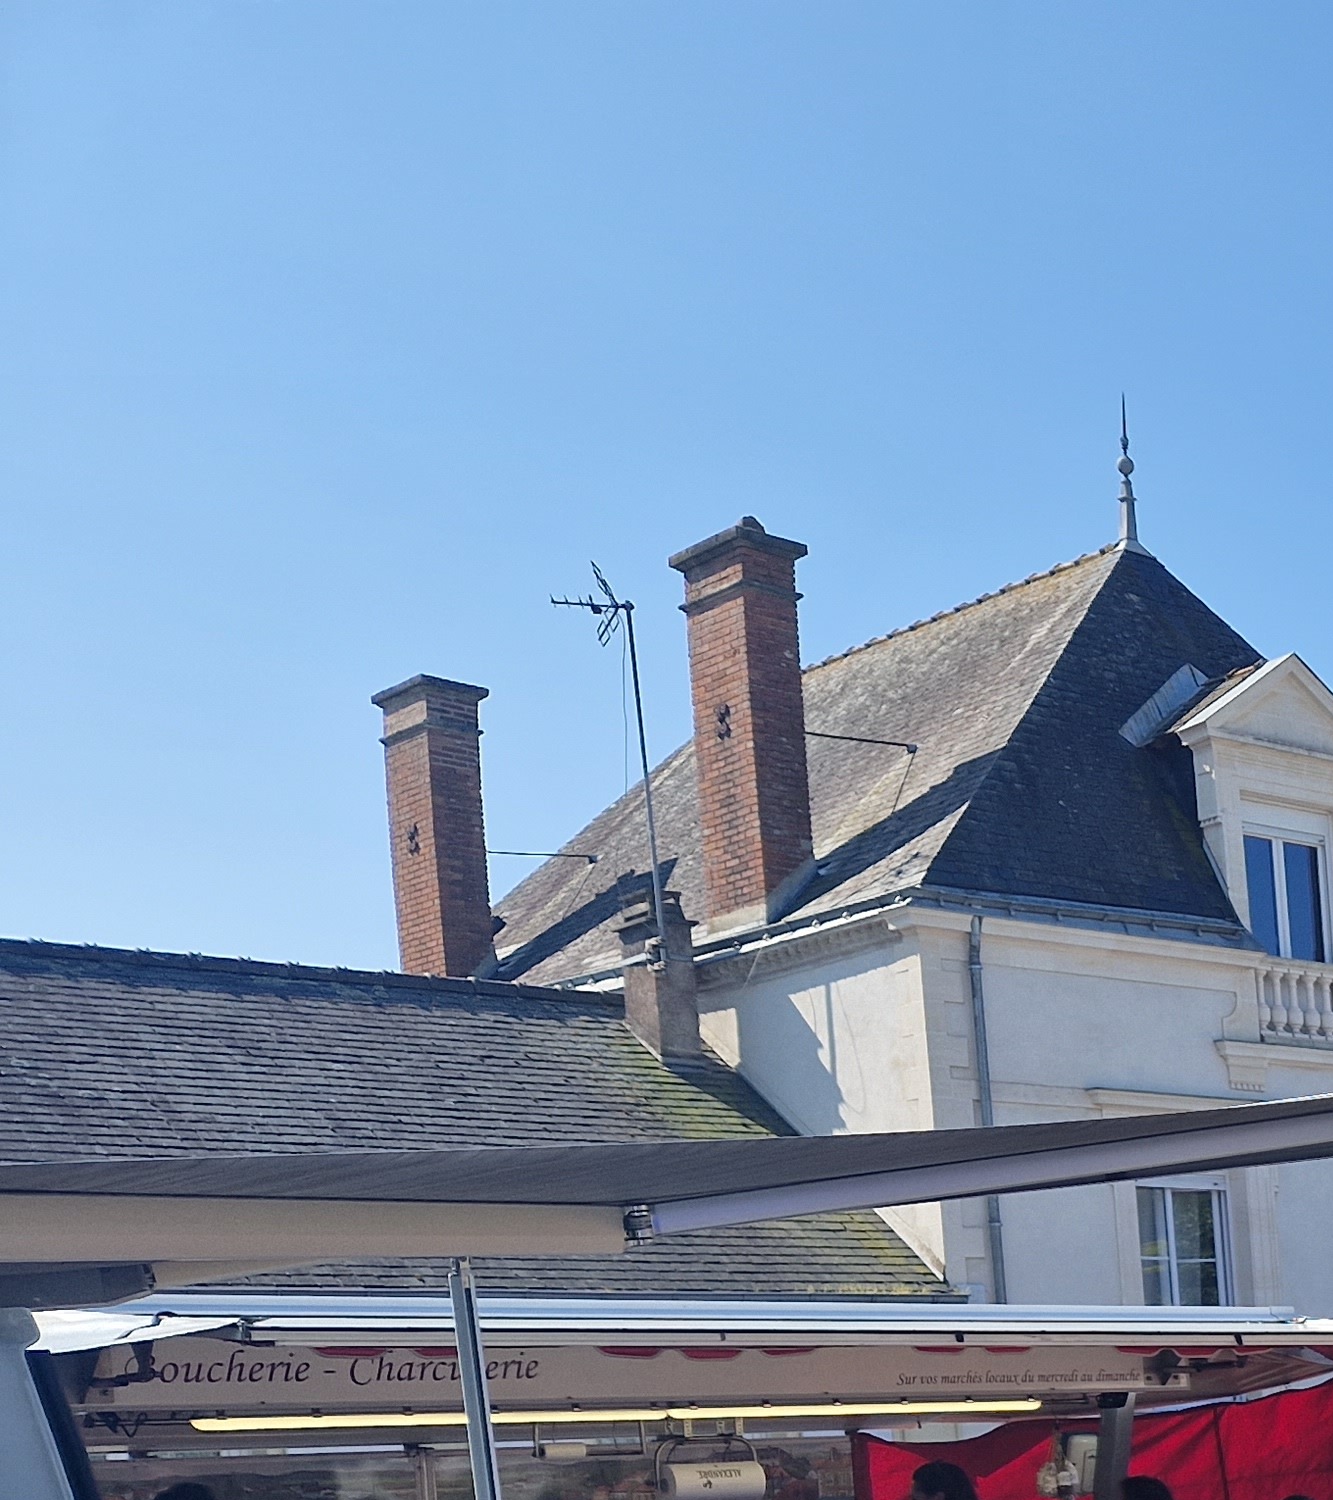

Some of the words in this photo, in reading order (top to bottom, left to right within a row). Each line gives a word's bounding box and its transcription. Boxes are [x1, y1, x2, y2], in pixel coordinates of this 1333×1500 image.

[349, 1350, 539, 1386] Charcuerie
[897, 1373, 916, 1386] Sur
[919, 1375, 938, 1385] vos
[941, 1371, 982, 1385] marchés
[985, 1371, 1020, 1385] locaux
[1021, 1370, 1034, 1383] du
[1038, 1370, 1078, 1383] mercredi
[1081, 1372, 1093, 1382] au
[1096, 1369, 1140, 1382] dimanche
